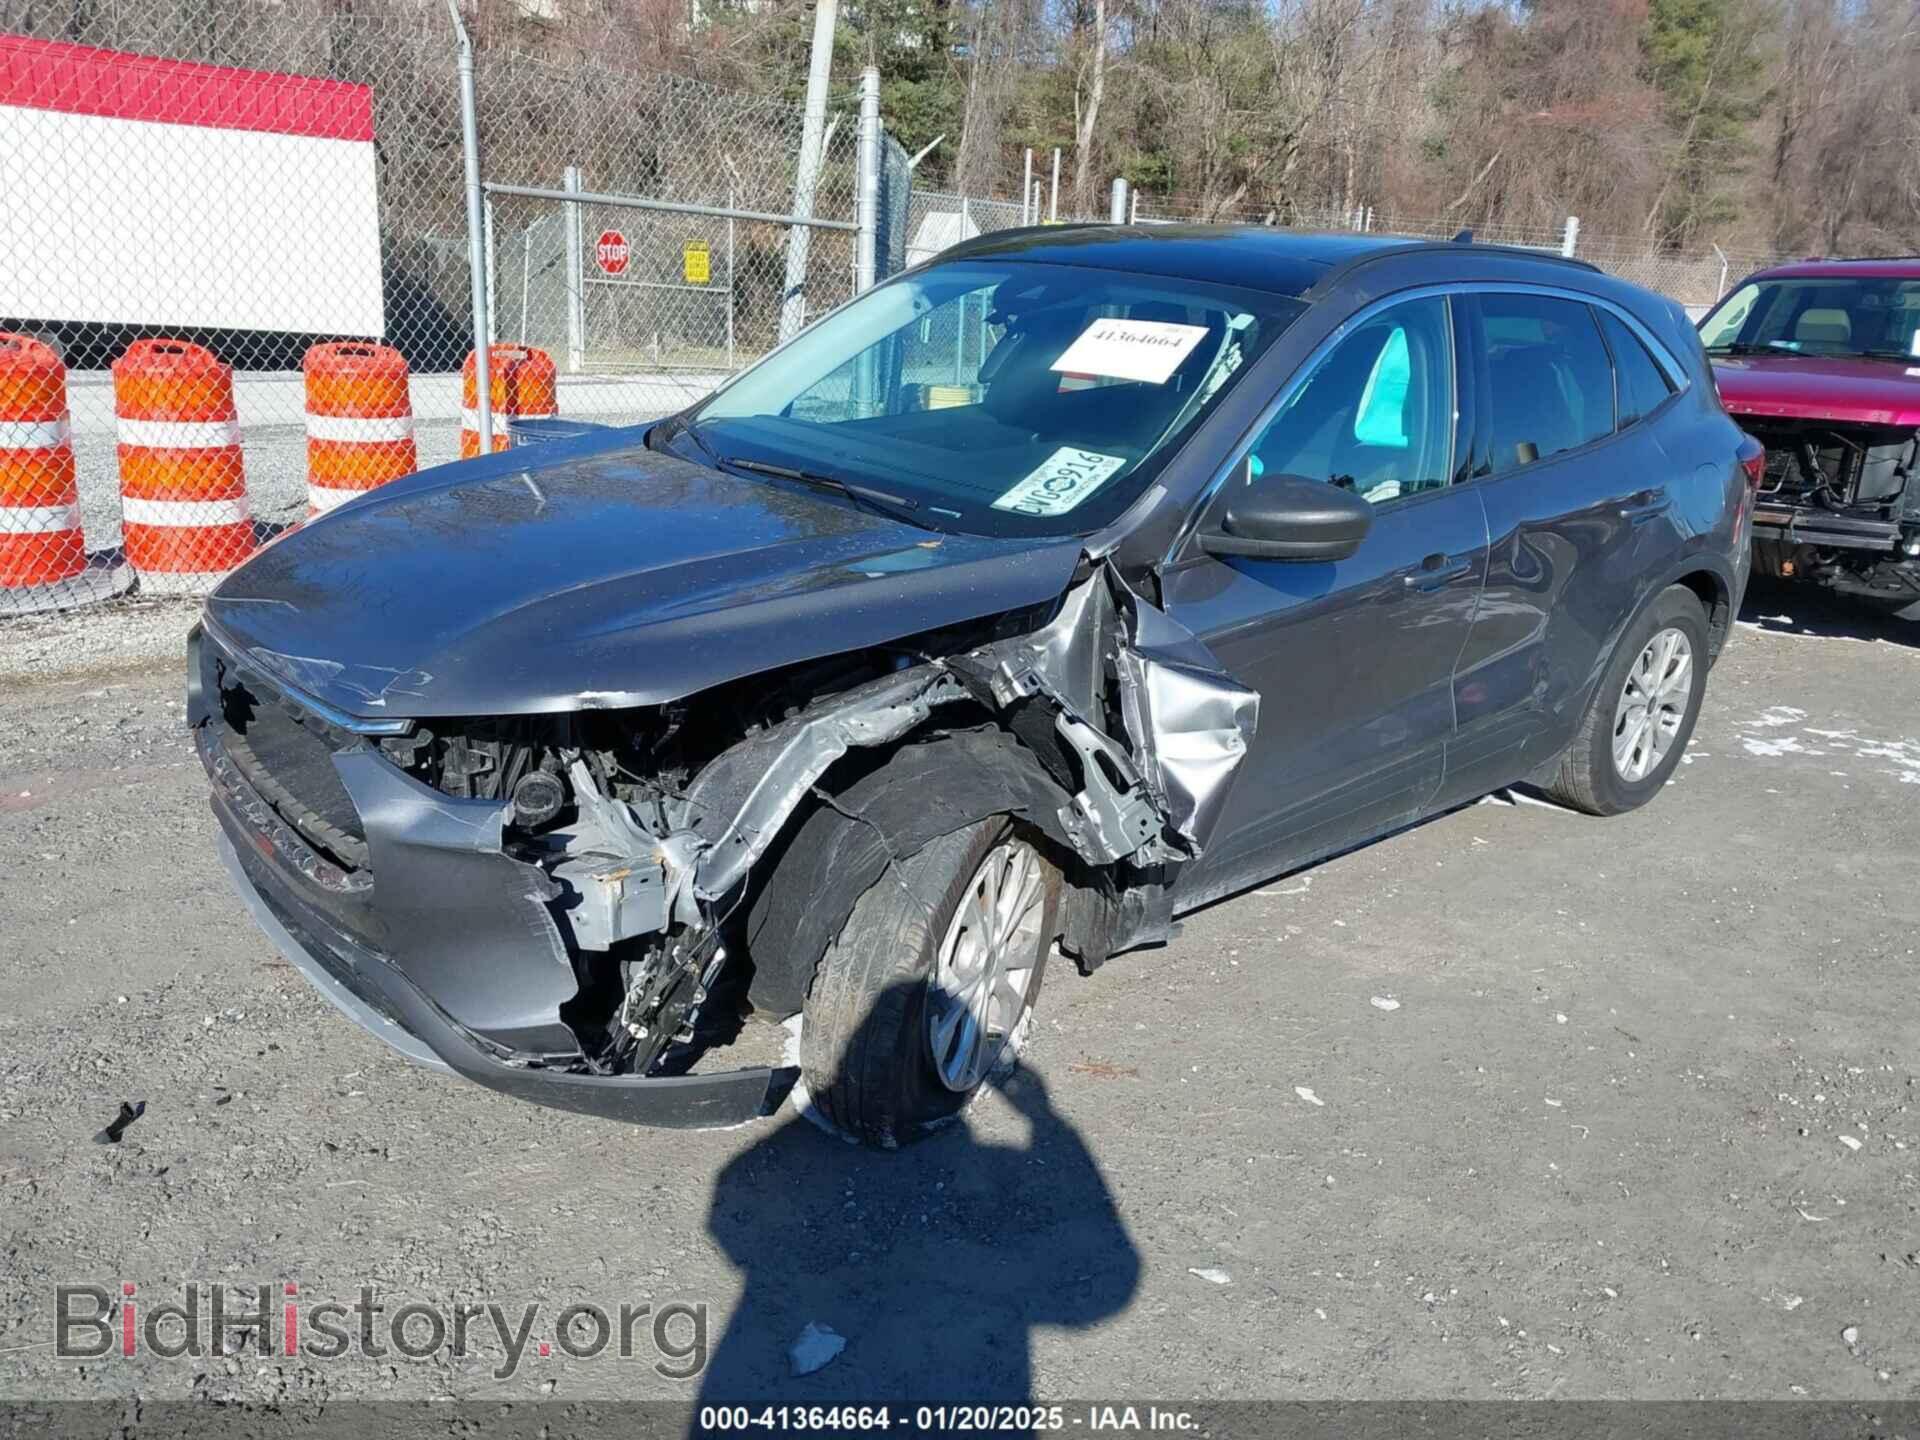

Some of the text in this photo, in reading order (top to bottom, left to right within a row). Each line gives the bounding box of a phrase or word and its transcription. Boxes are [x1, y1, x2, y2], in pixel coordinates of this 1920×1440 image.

[598, 244, 627, 261] STOP
[1093, 330, 1184, 348] 41364664
[1057, 452, 1104, 478] 916
